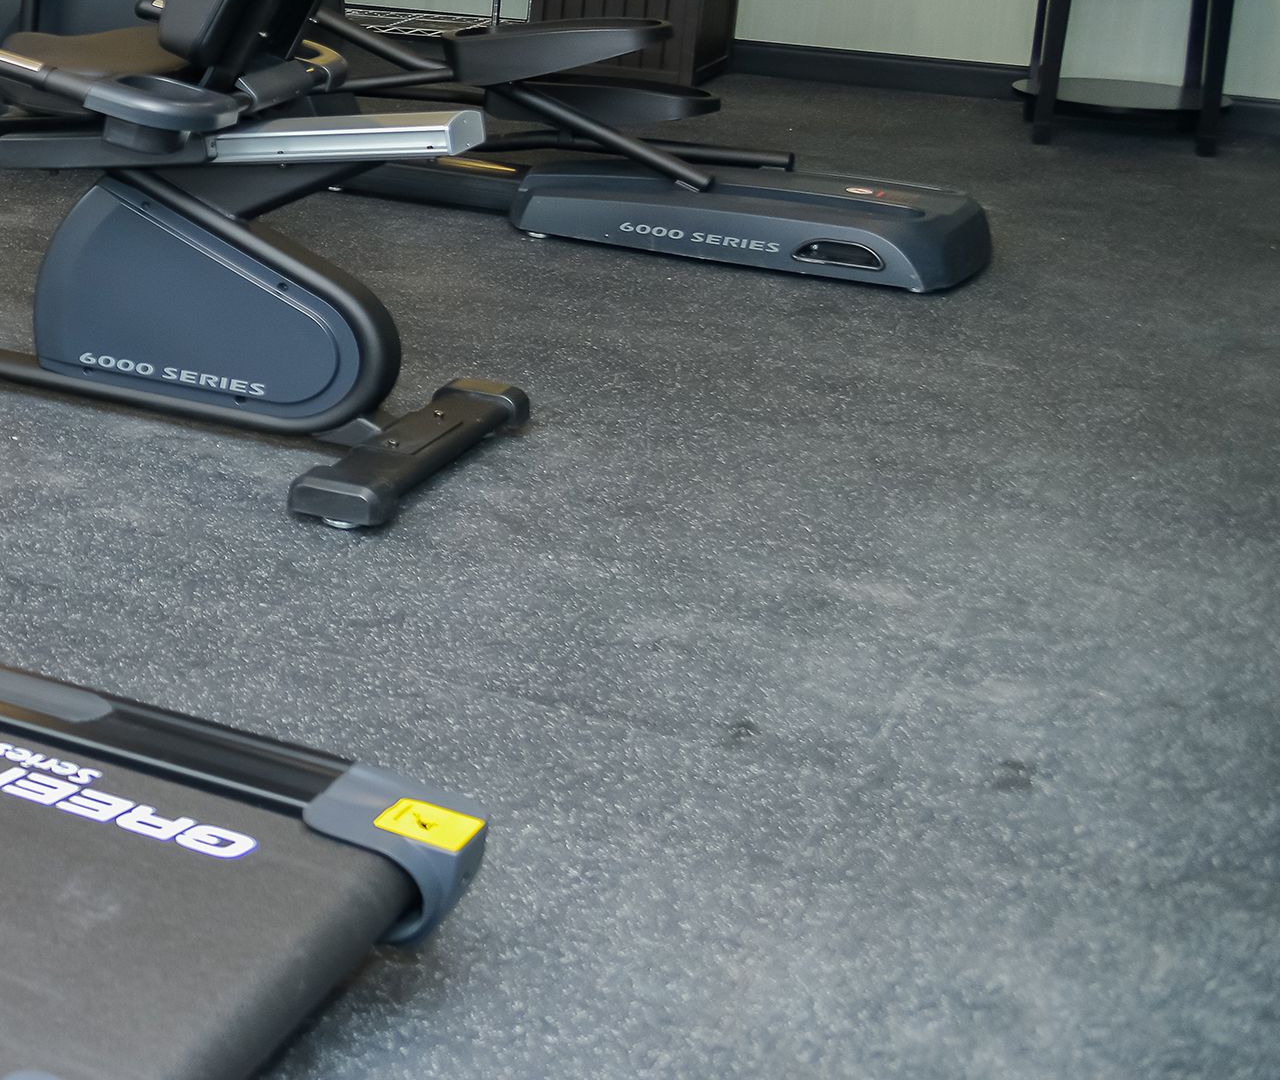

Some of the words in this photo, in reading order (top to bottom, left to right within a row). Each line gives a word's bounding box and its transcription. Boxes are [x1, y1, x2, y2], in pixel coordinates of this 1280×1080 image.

[619, 222, 685, 240] 6000
[690, 232, 780, 253] SERIES
[79, 352, 154, 375] 6000
[161, 367, 265, 396] SERIES
